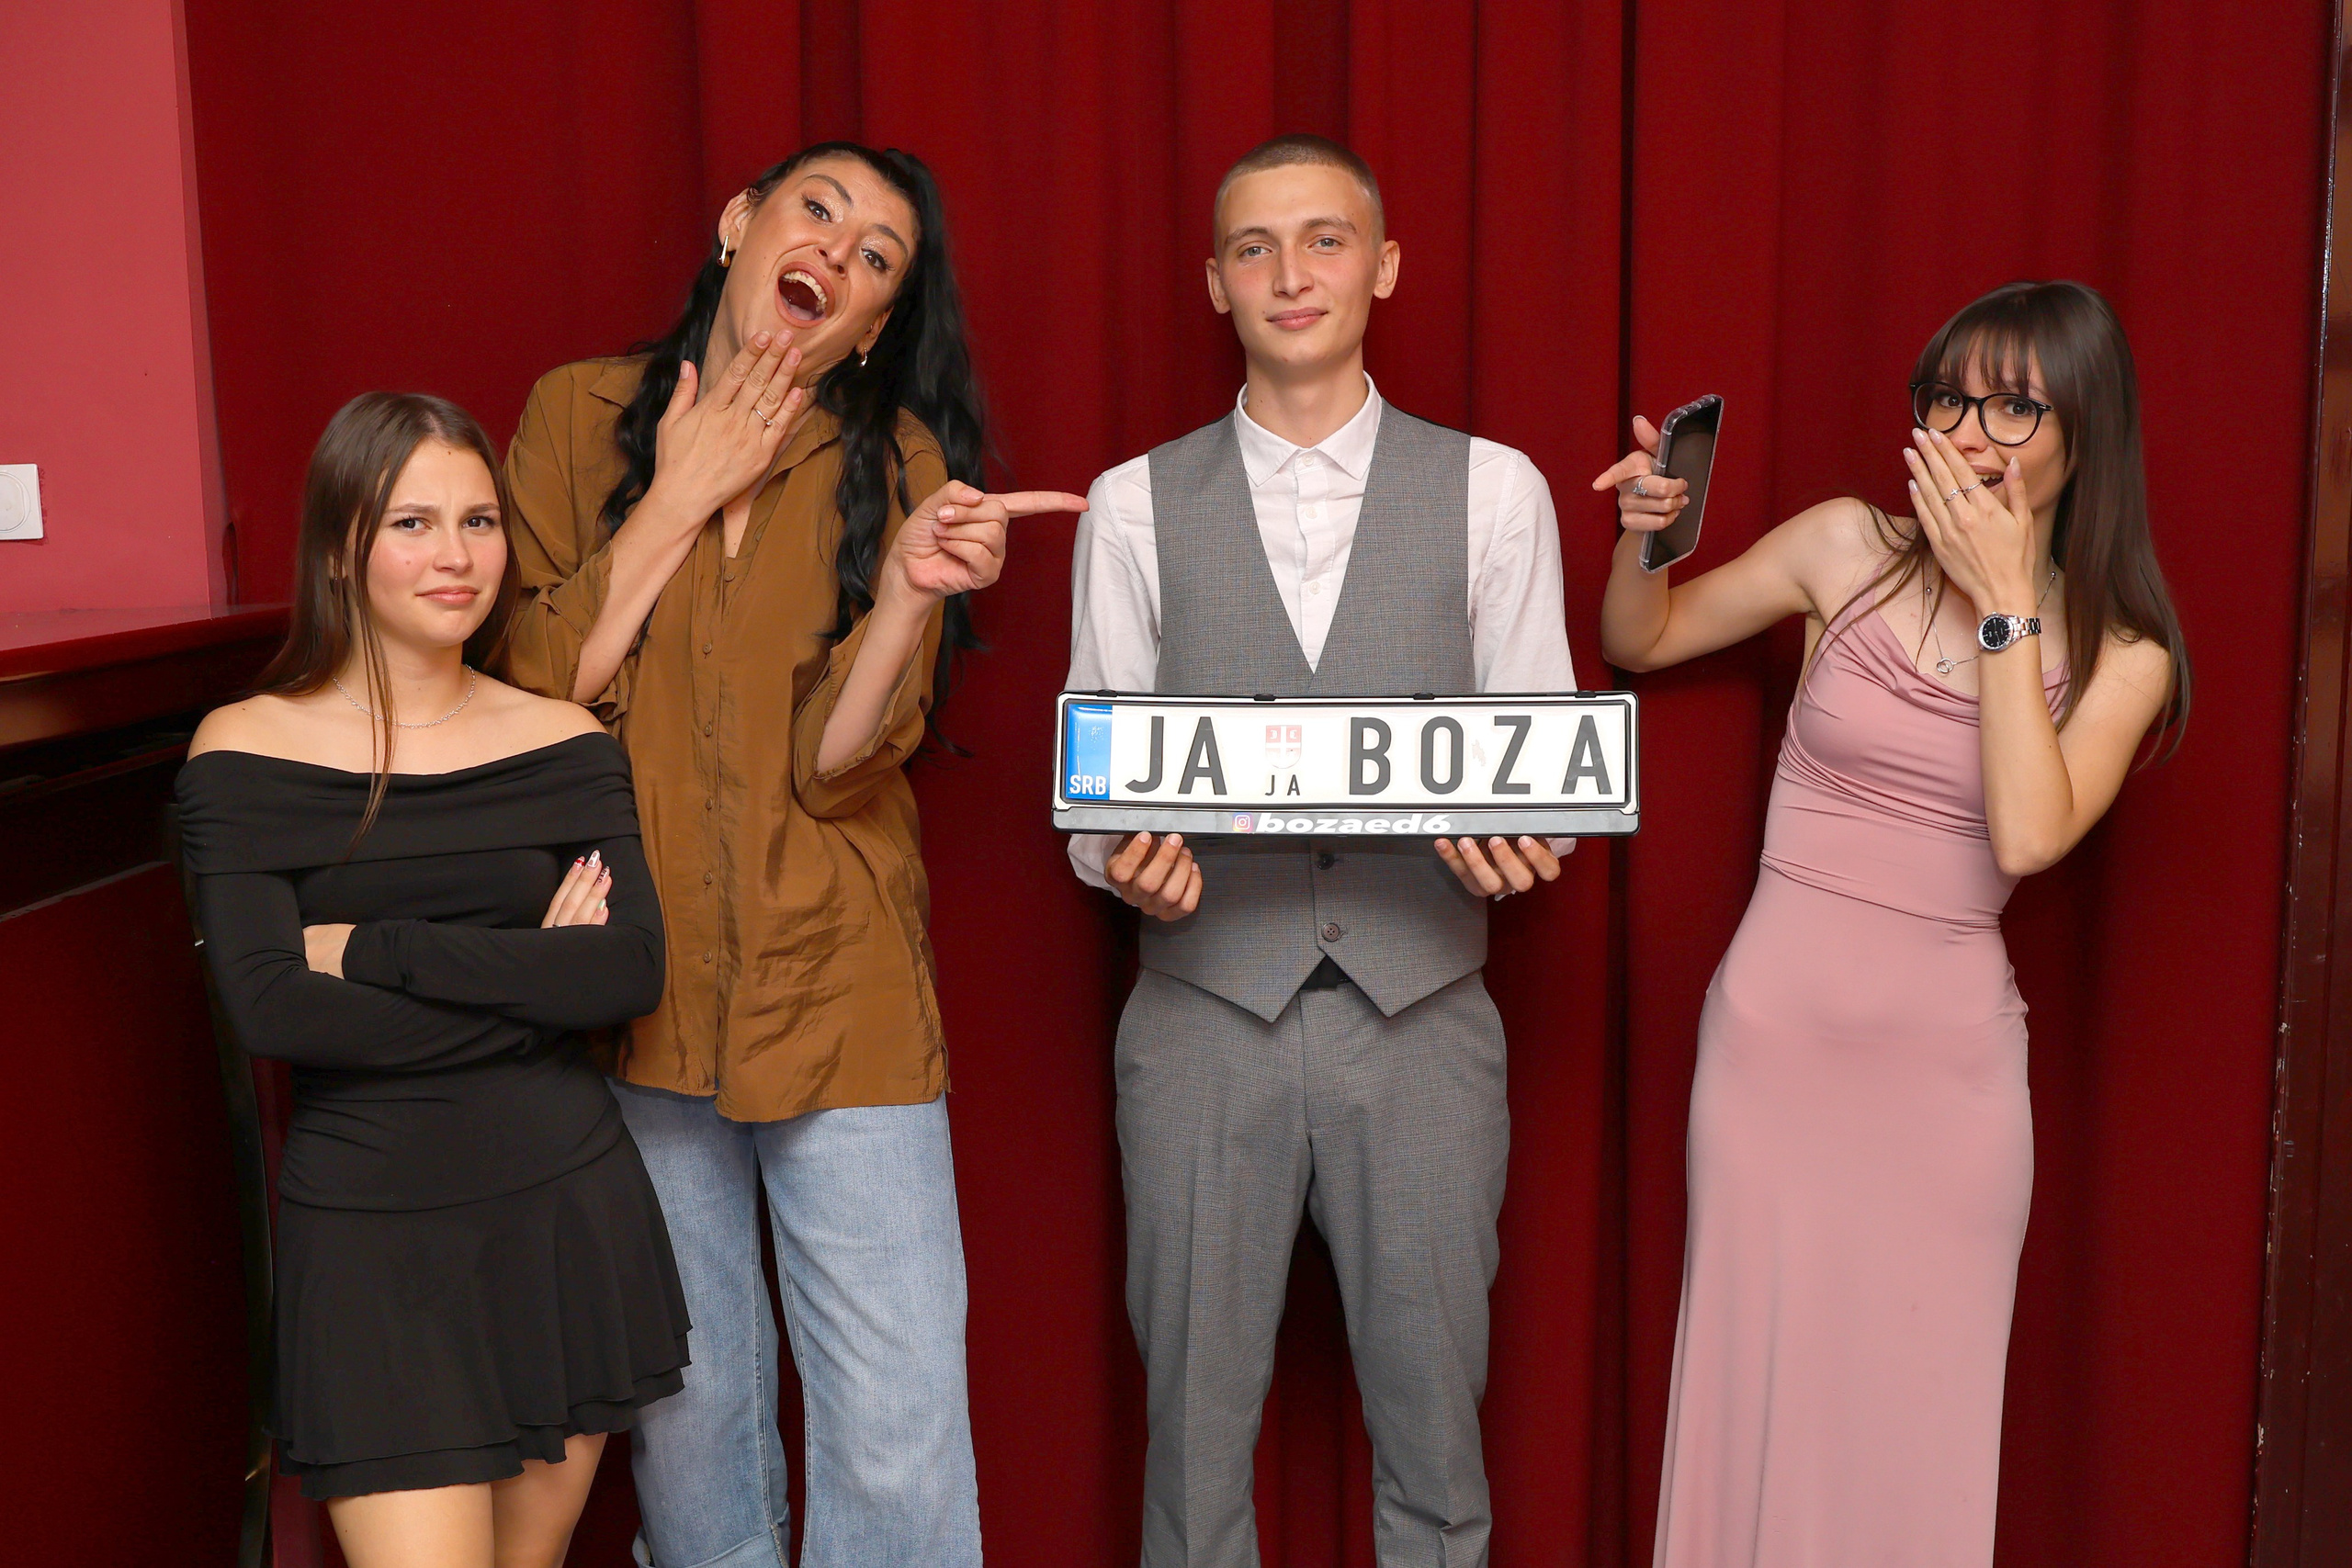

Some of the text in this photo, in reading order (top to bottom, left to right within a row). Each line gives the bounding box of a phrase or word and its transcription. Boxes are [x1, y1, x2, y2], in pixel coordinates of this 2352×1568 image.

[1125, 716, 1612, 795] JA BOZA
[1069, 774, 1107, 795] SRB
[1264, 774, 1300, 796] JA
[1256, 813, 1451, 834] bozaed6
